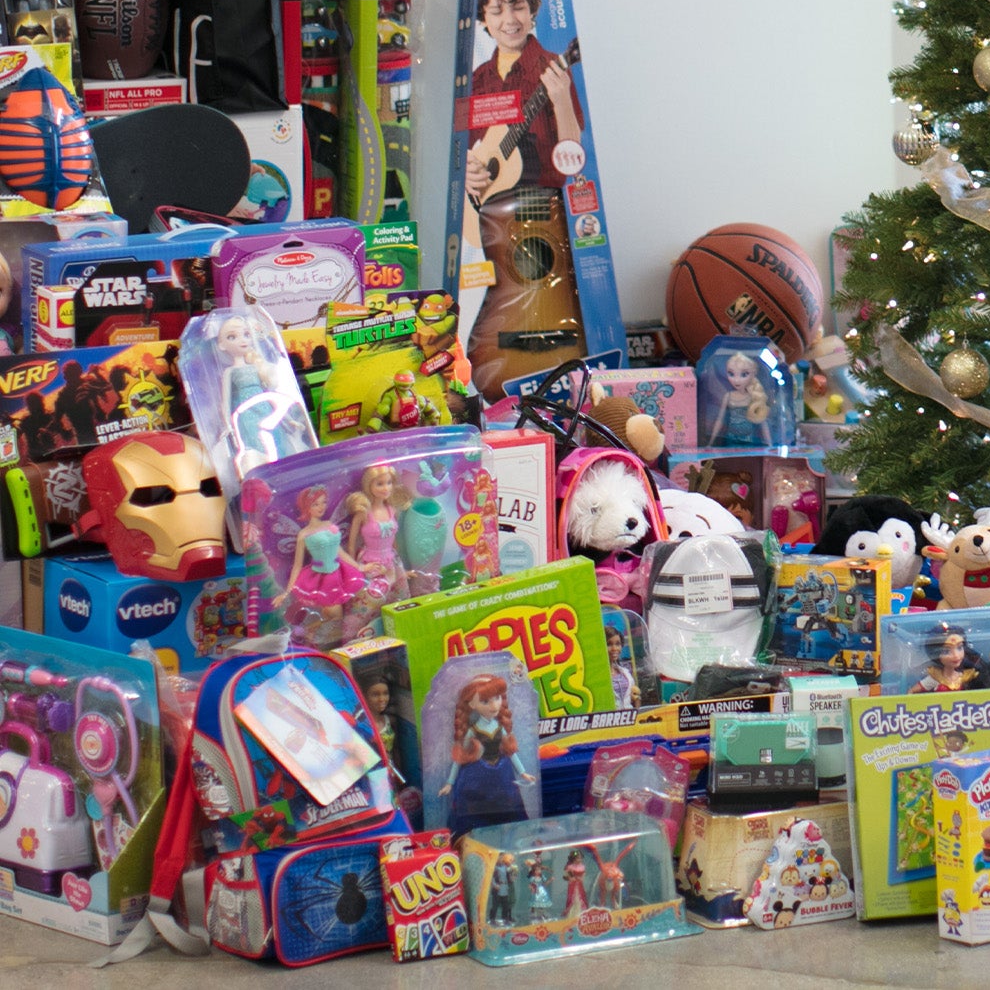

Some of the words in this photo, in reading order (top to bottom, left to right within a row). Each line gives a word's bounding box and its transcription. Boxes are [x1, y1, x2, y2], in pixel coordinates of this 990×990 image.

[109, 91, 125, 99] NFL
[127, 90, 141, 98] ALL
[144, 89, 162, 97] PRO
[314, 188, 331, 211] P
[373, 235, 399, 244] Activity
[401, 233, 414, 242] Pad
[374, 227, 404, 236] Coloring
[404, 226, 409, 234] &
[84, 277, 146, 293] STAR
[312, 271, 333, 286] Easy
[747, 243, 819, 328] SPALDING
[84, 291, 146, 307] WARS
[334, 319, 416, 350] TURTLES
[0, 360, 57, 394] NERF
[520, 374, 571, 396] Fist
[96, 415, 149, 435] LEVER-ACTION
[401, 410, 418, 422] STOP
[499, 497, 536, 521] LAB
[60, 594, 90, 617] vtech
[118, 600, 176, 621] vtech
[433, 611, 446, 619] THE
[469, 602, 478, 610] OF
[480, 596, 502, 607] CRAZY
[699, 700, 754, 713] WARNING:
[810, 701, 842, 710] SPEAKER
[538, 719, 558, 735] IRE
[560, 715, 590, 732] LONG
[591, 710, 637, 728] BARREL!
[862, 708, 926, 735] Chutes
[863, 753, 875, 764] The
[875, 745, 900, 761] Exciting
[900, 742, 919, 751] Game
[876, 761, 888, 771] Ups
[392, 854, 462, 910] UNO
[801, 905, 828, 915] BUBBLE
[831, 902, 853, 910] FEVER
[423, 925, 429, 934] 4
